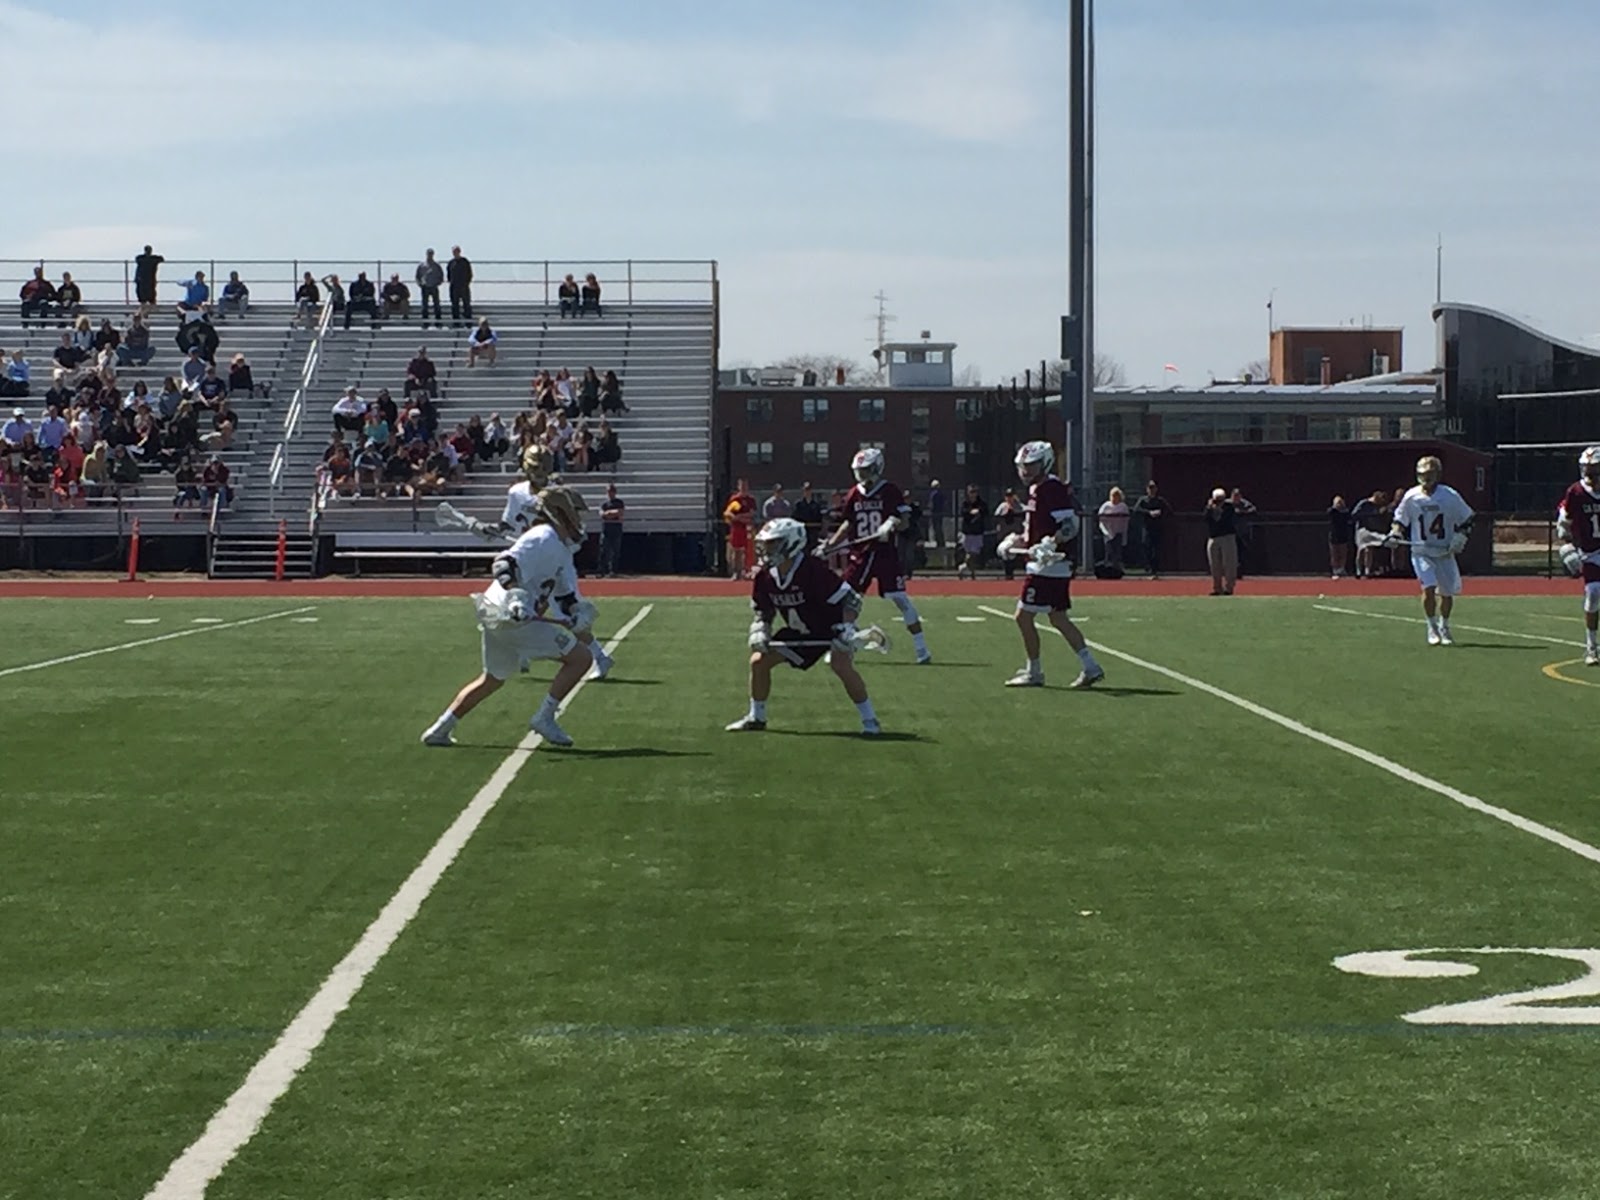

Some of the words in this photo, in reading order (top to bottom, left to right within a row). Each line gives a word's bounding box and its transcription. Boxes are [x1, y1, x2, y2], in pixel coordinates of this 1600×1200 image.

[856, 511, 881, 538] 28
[1418, 513, 1445, 540] 14
[1026, 587, 1036, 603] 2
[1332, 946, 1600, 1026] 2
